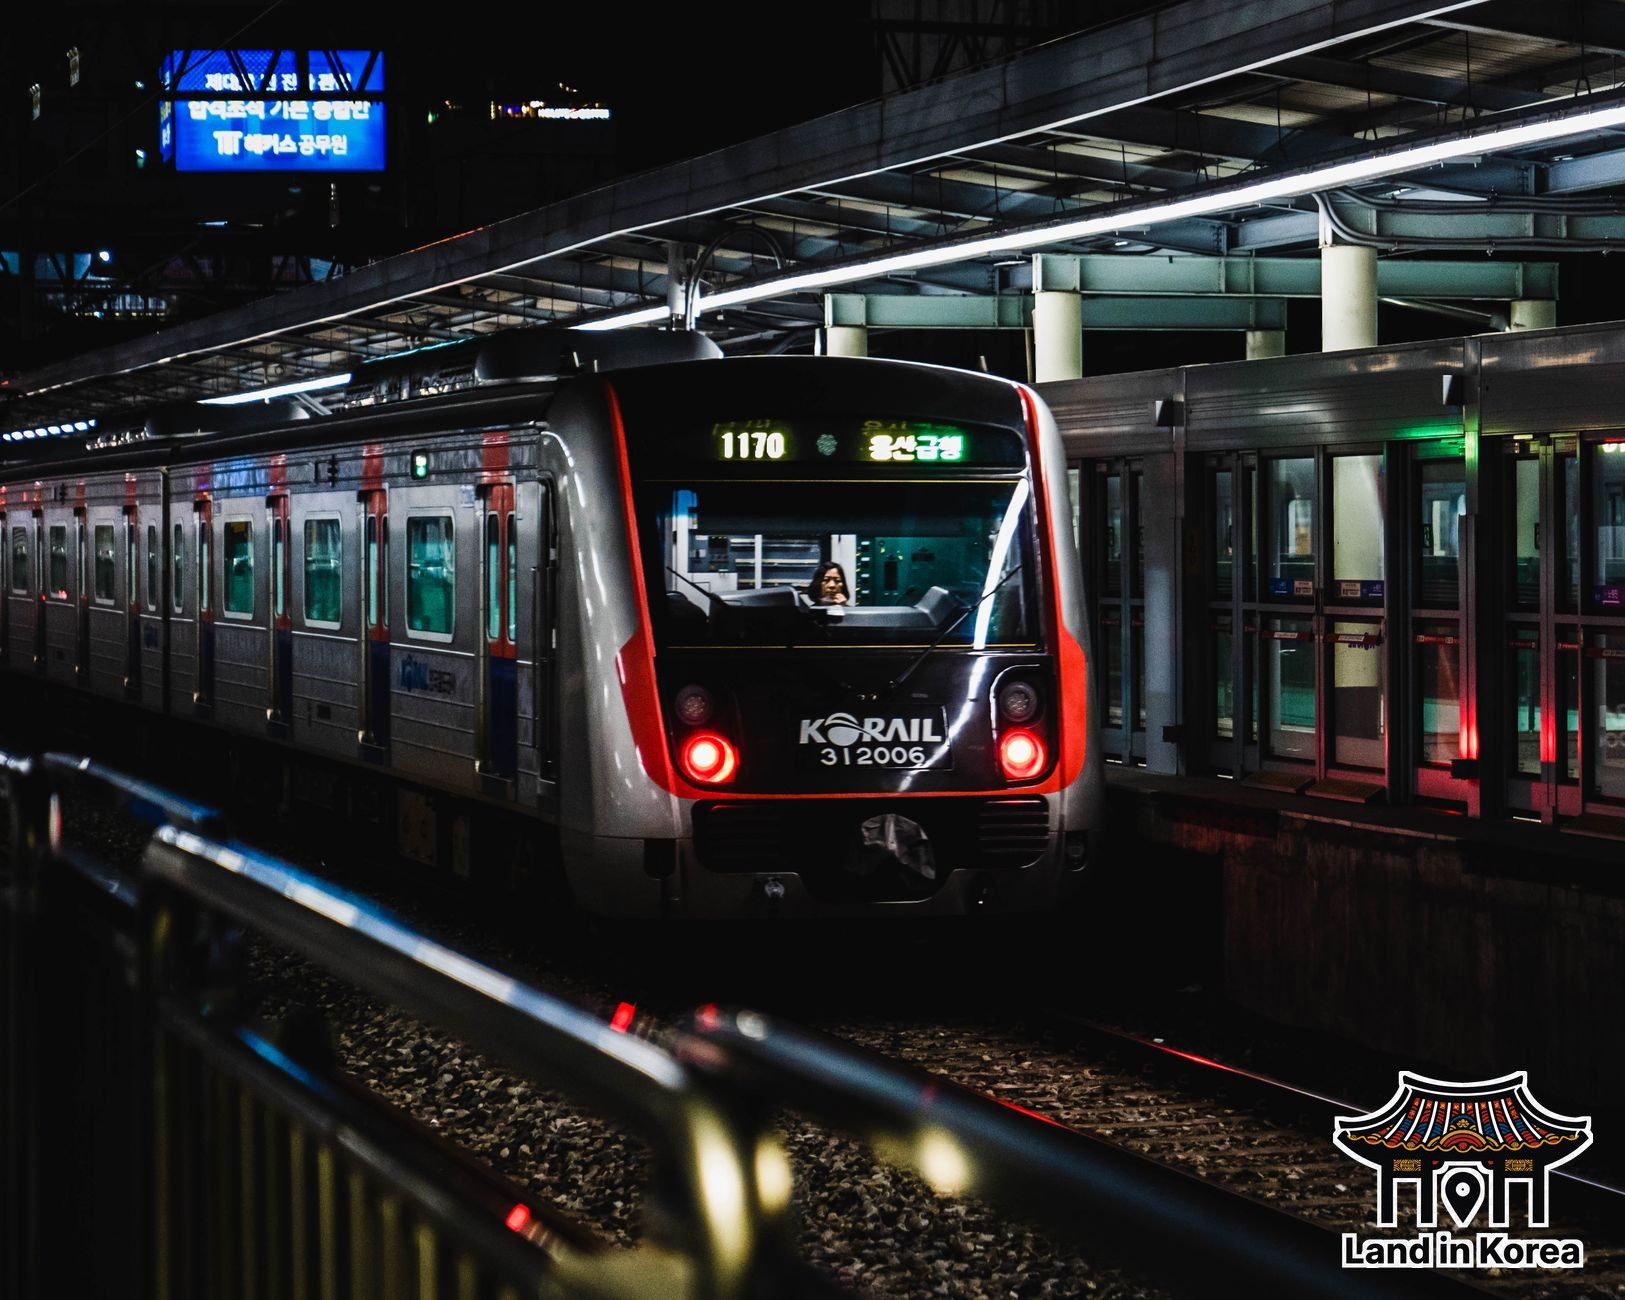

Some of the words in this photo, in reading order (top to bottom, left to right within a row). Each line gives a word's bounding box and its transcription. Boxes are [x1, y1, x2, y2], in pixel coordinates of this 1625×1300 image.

[244, 133, 297, 154] 해커스
[298, 134, 347, 155] 공무원
[721, 431, 785, 459] 1170
[799, 712, 942, 747] KORAIL
[820, 746, 925, 766] 312006
